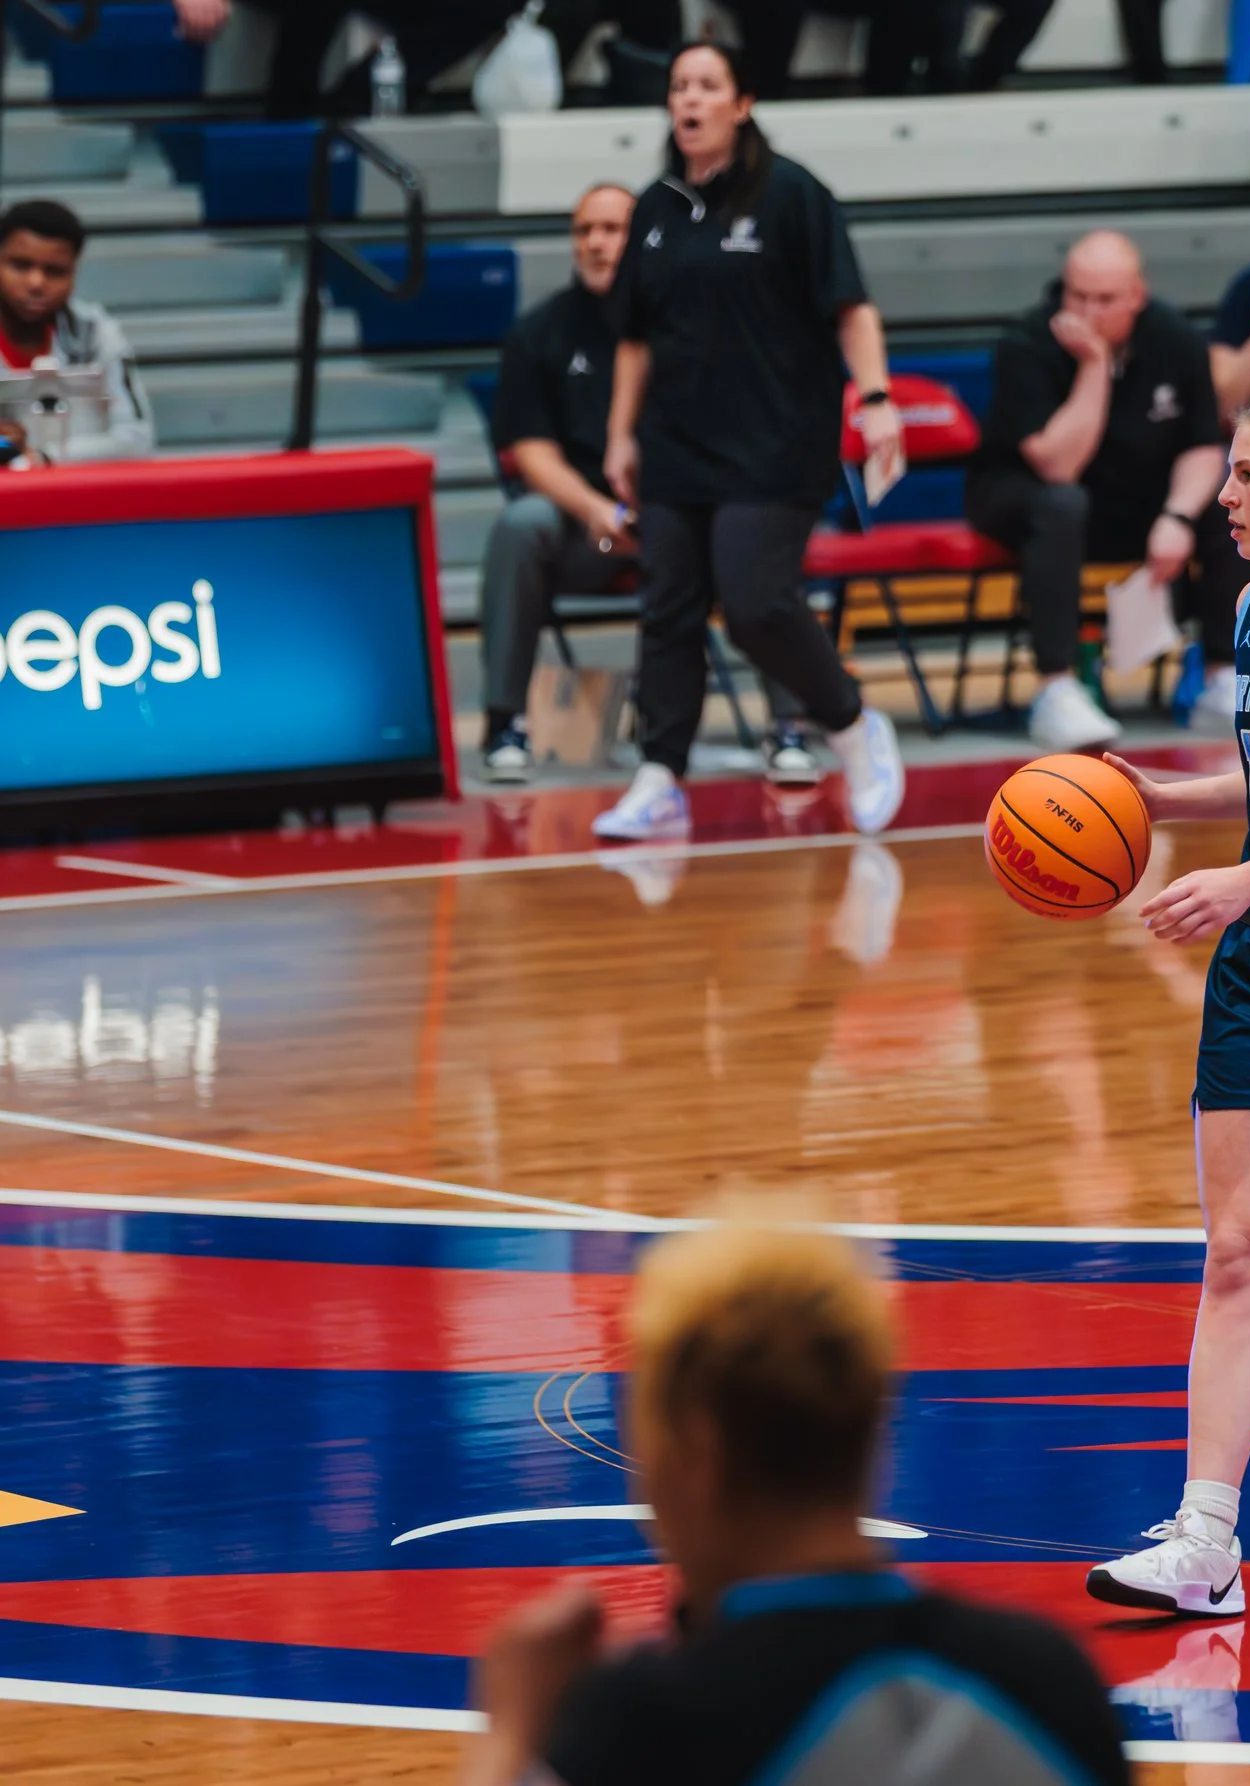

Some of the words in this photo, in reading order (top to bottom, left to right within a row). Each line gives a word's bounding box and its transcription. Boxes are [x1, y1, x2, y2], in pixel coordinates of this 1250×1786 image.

[0, 578, 221, 711] epsi
[991, 813, 1080, 902] Wilson
[1052, 804, 1084, 833] NFHS
